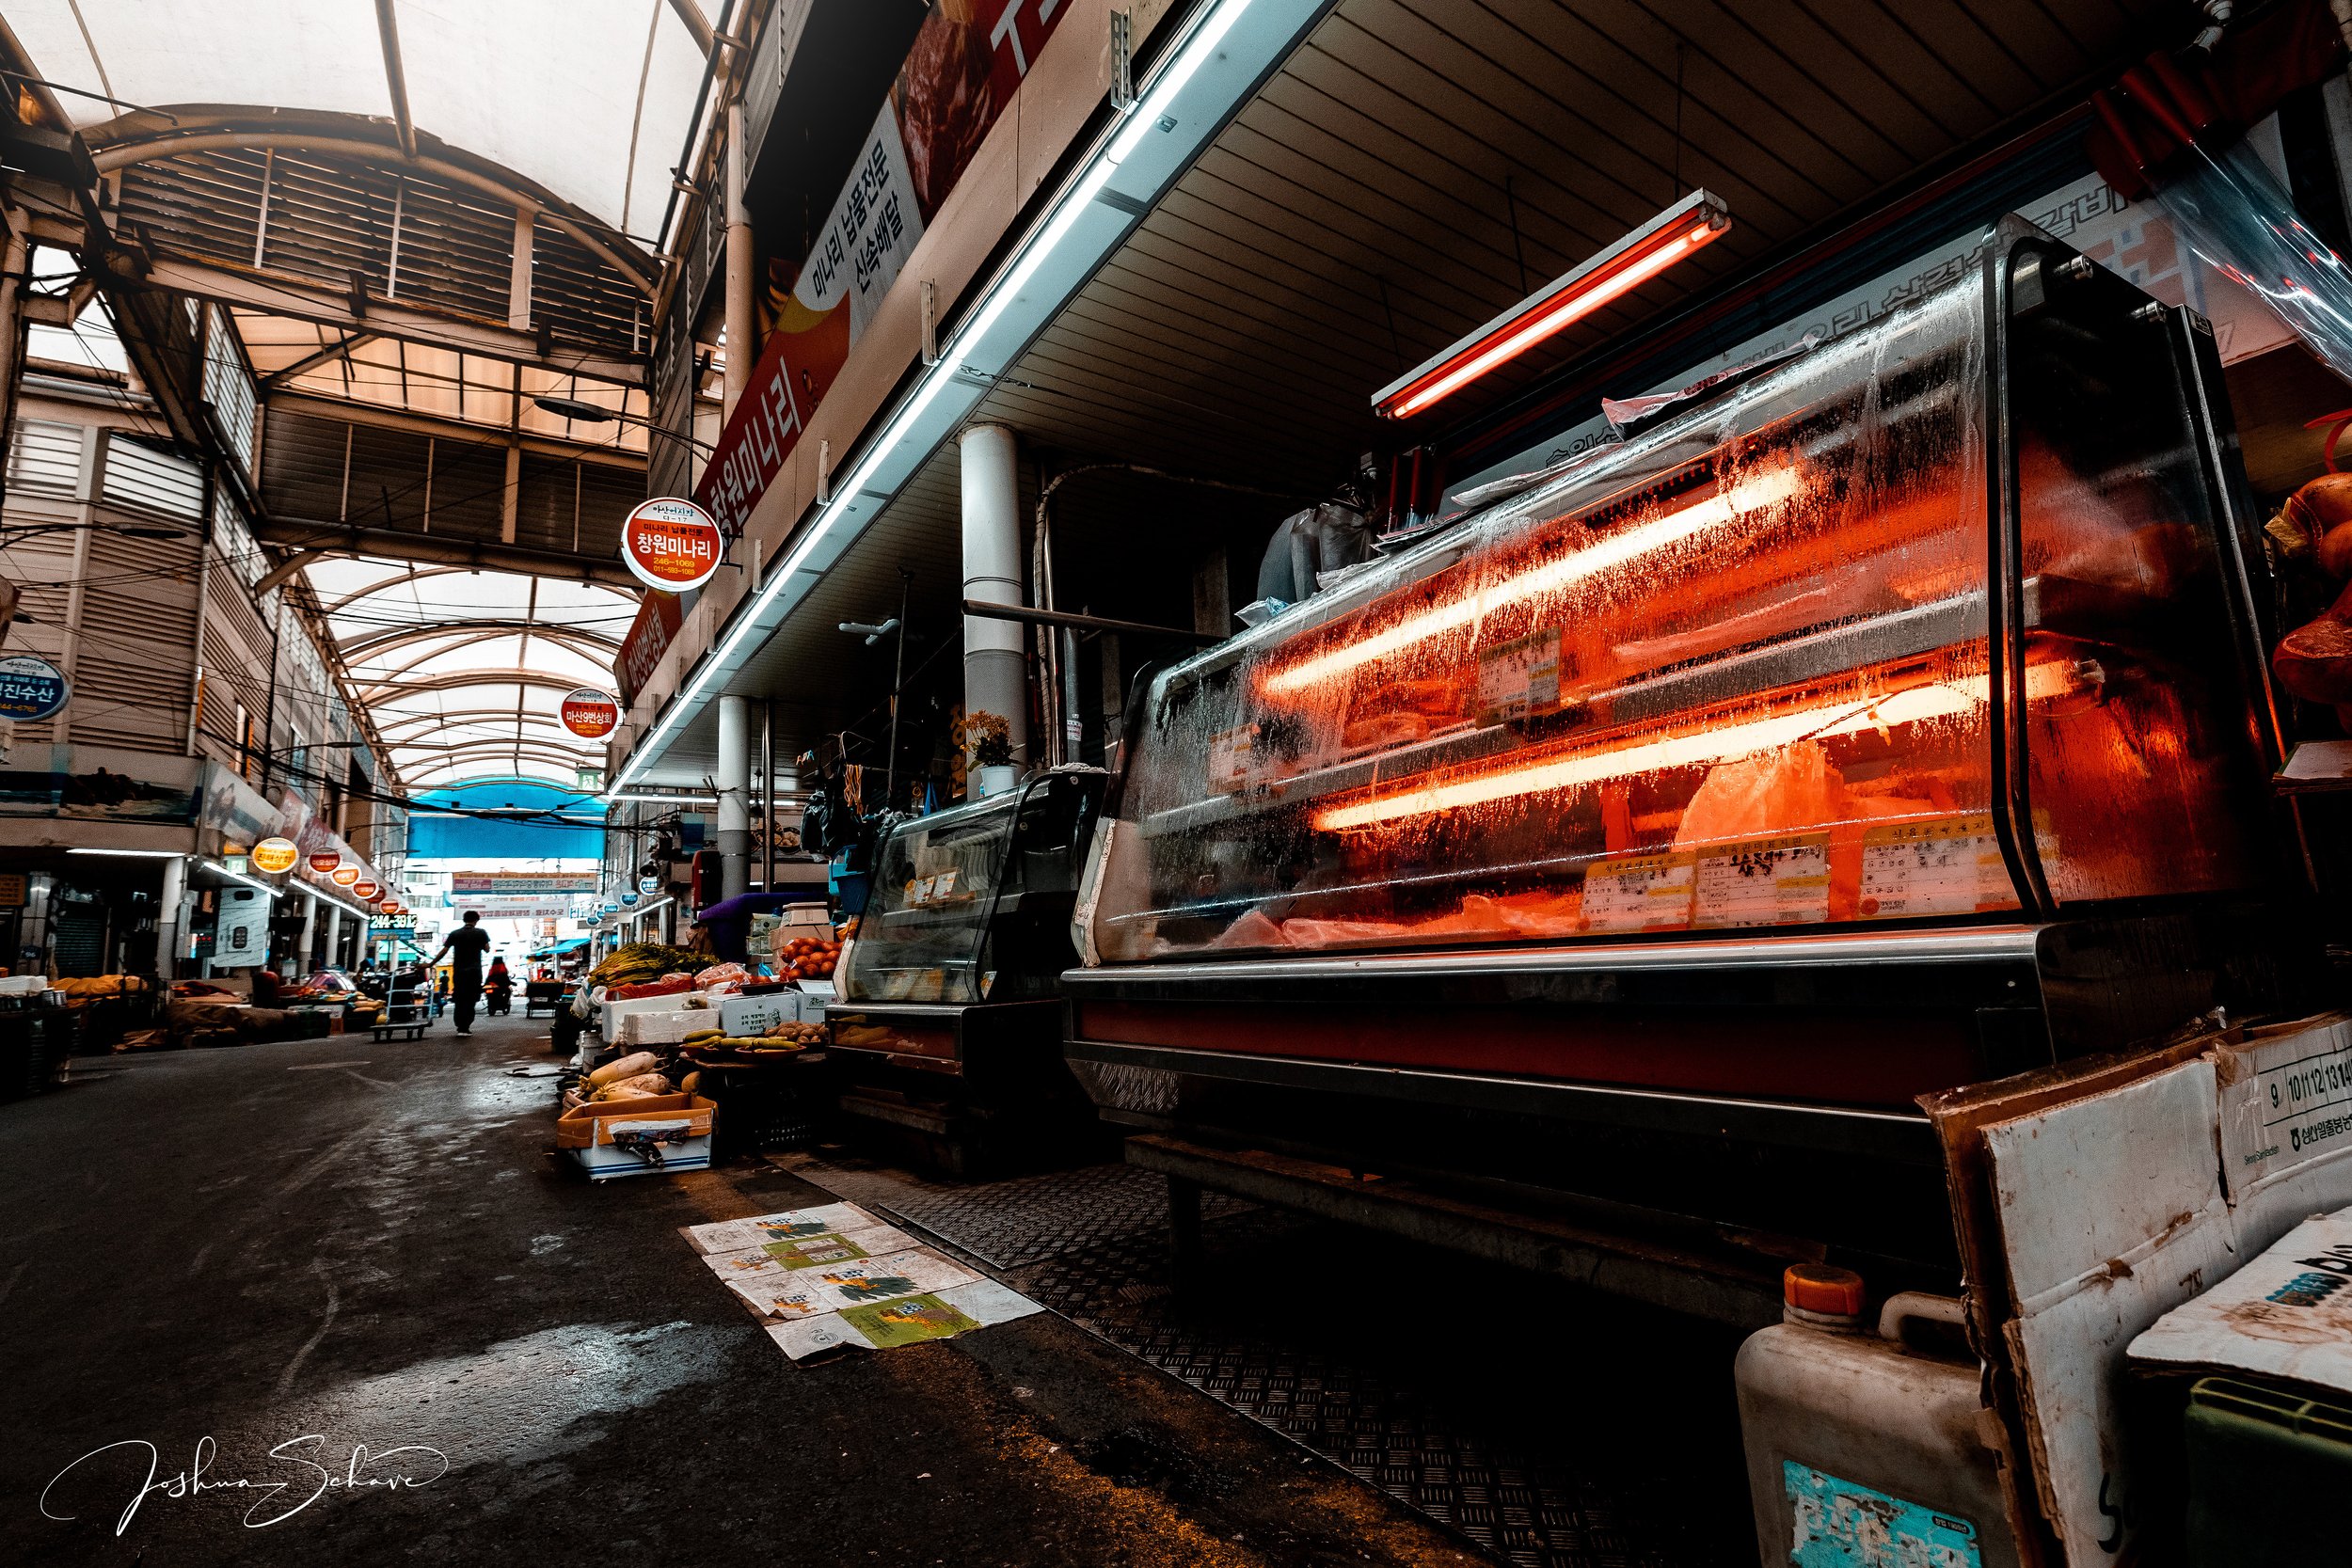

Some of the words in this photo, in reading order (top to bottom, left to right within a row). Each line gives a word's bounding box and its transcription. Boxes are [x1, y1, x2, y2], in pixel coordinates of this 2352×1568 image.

[812, 226, 845, 299] 미나리
[841, 138, 890, 247] 납품전문
[855, 190, 903, 295] 신속배달
[710, 355, 802, 548] 창원미나리
[644, 523, 668, 532] 미나리
[671, 526, 704, 536] 납품전문
[637, 532, 711, 561] 창원미나리
[653, 557, 695, 568] 246-1069
[566, 710, 612, 725] 마산9번상회
[2269, 1083, 2279, 1109] 9
[2288, 1075, 2301, 1101] 10
[2301, 1072, 2312, 1098] 11
[2311, 1068, 2325, 1094] 12
[2326, 1065, 2339, 1090] 13
[2338, 1060, 2352, 1087] 14
[2301, 1113, 2352, 1146] 성산일출봉농
